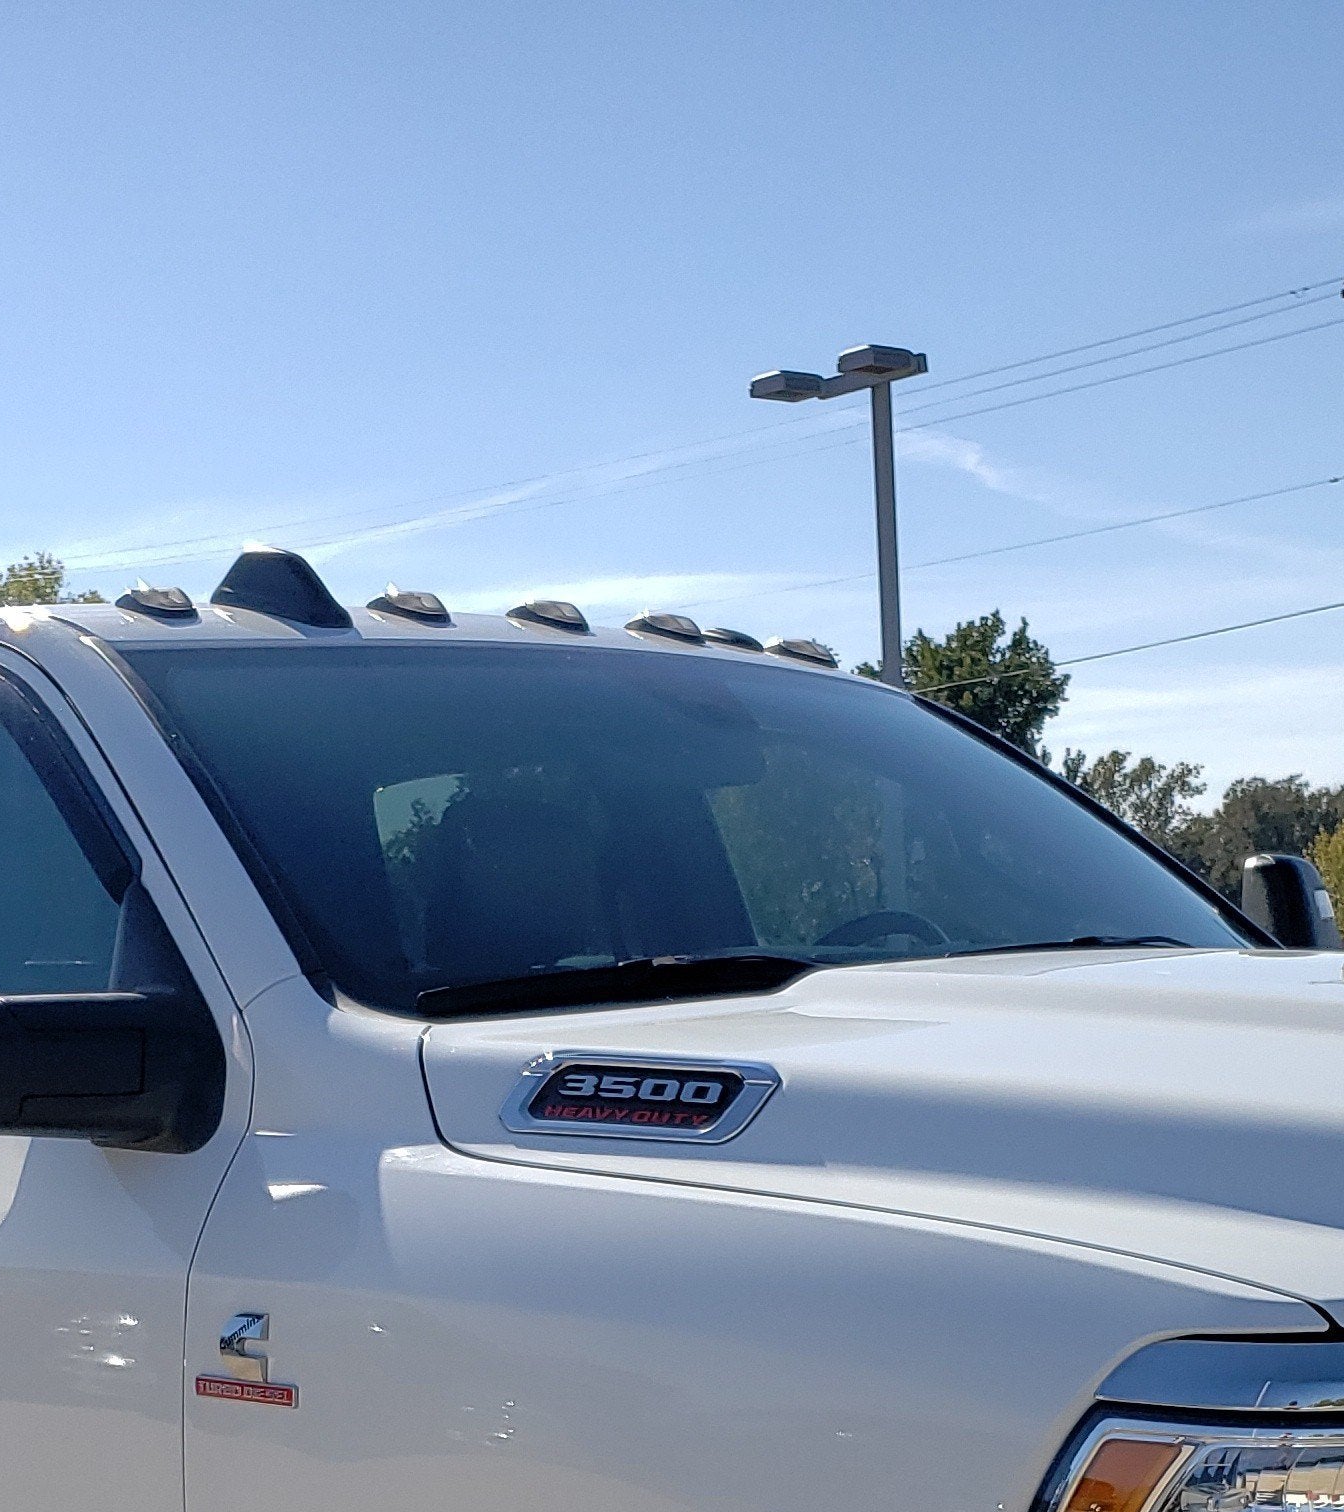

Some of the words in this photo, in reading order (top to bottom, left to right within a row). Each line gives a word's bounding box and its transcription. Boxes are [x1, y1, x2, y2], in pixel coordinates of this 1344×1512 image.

[558, 1074, 723, 1104] 3500
[544, 1105, 628, 1121] HEAVY
[631, 1110, 709, 1126] DUTY
[198, 1381, 241, 1396] TURBO
[243, 1386, 288, 1402] DIESEL
